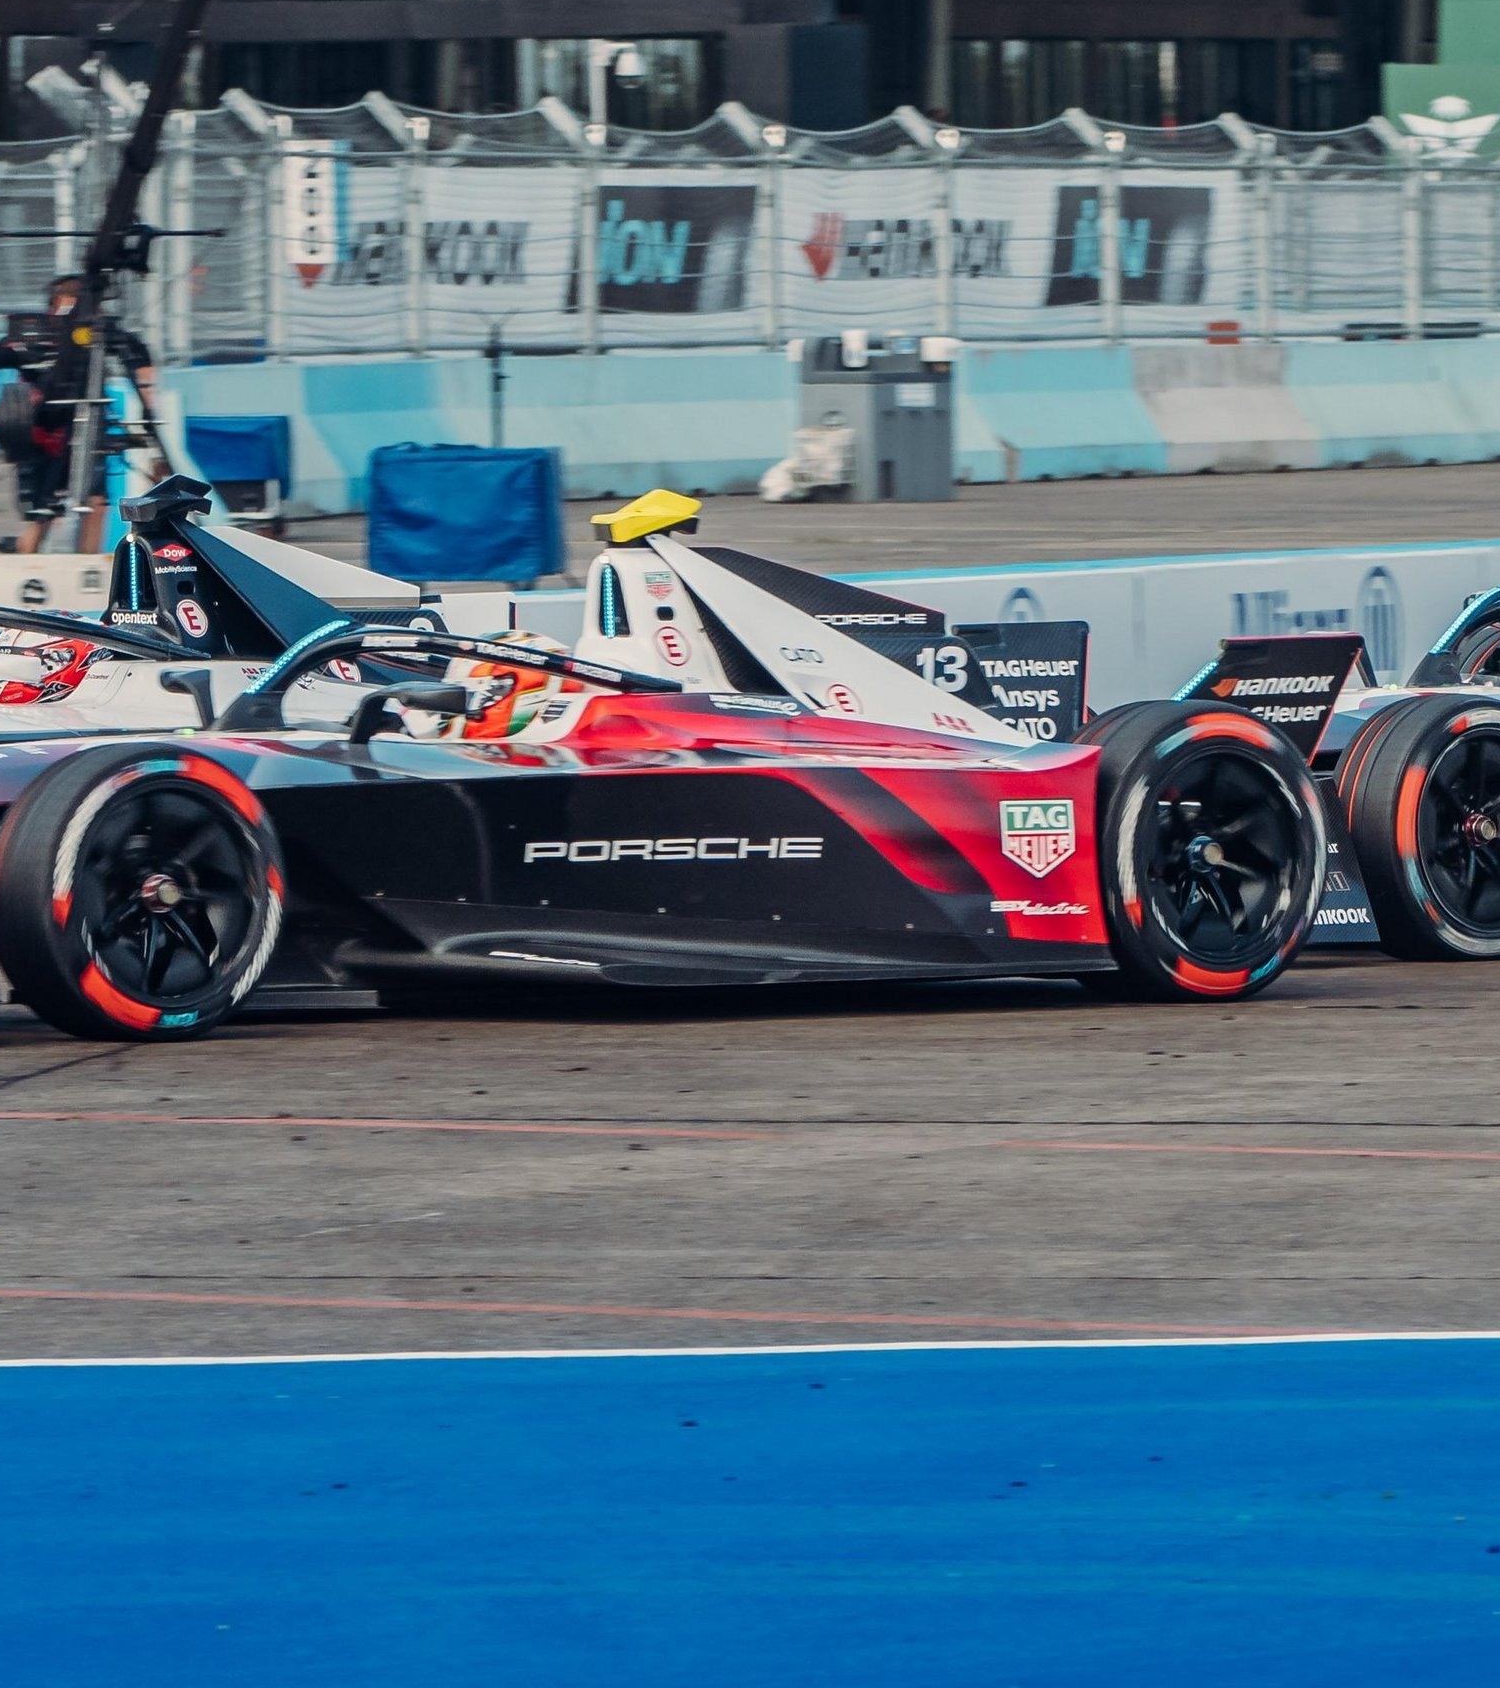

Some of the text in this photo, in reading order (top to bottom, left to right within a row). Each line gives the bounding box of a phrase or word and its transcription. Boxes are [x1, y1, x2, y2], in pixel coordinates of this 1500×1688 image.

[111, 611, 158, 625] opentext
[814, 613, 928, 626] PORSCHE
[916, 645, 968, 693] 13
[980, 660, 1079, 678] TAGHeuer
[1007, 805, 1068, 829] TAG
[523, 837, 824, 863] PORSCHE
[1007, 834, 1071, 872] HEUER
[1313, 907, 1371, 926] NKOOK
